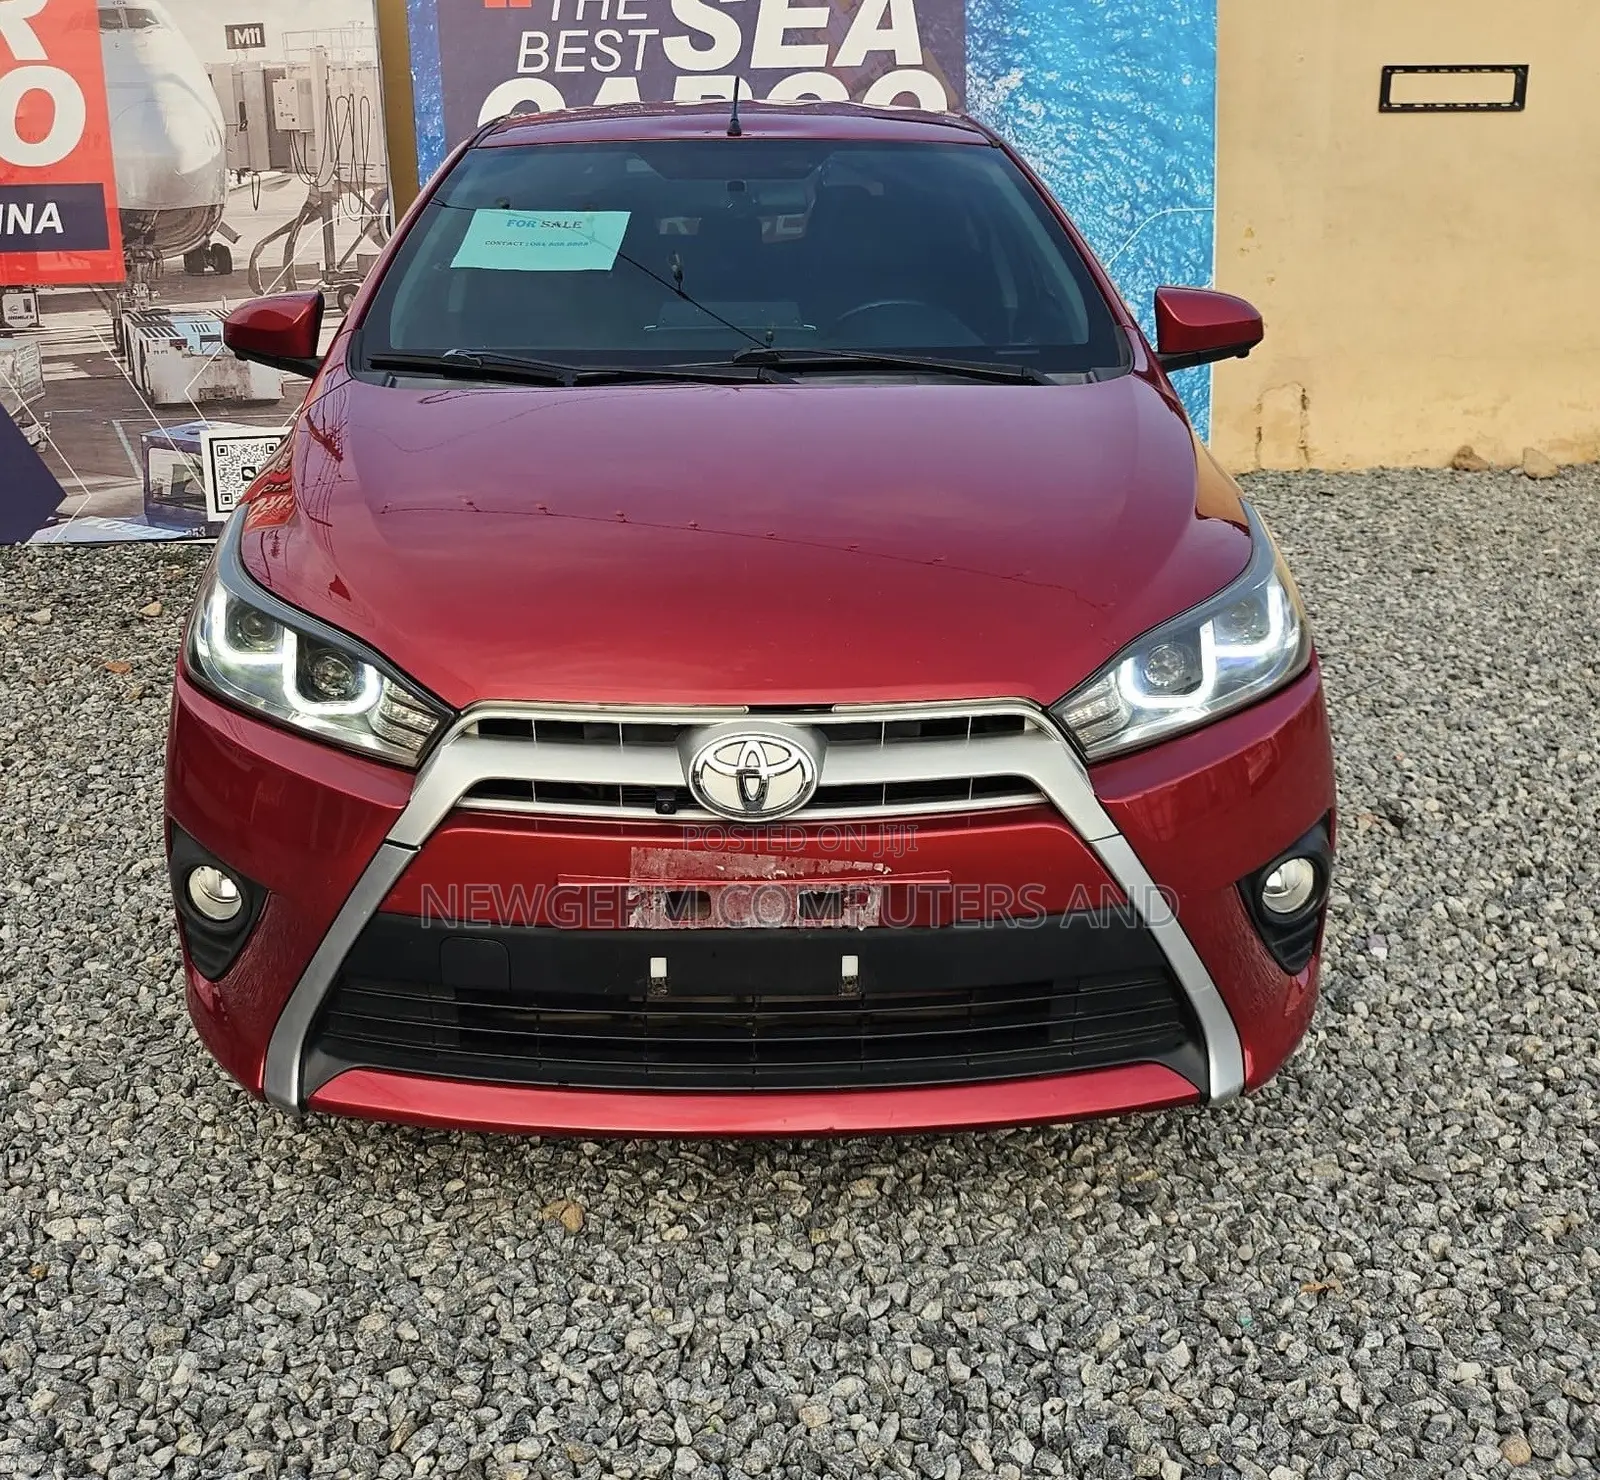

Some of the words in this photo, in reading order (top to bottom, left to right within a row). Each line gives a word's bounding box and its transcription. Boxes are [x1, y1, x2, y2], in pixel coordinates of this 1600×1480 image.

[517, 29, 660, 73] BEST
[662, 0, 923, 71] SEA
[506, 219, 537, 228] FOR
[540, 220, 583, 229] SALE
